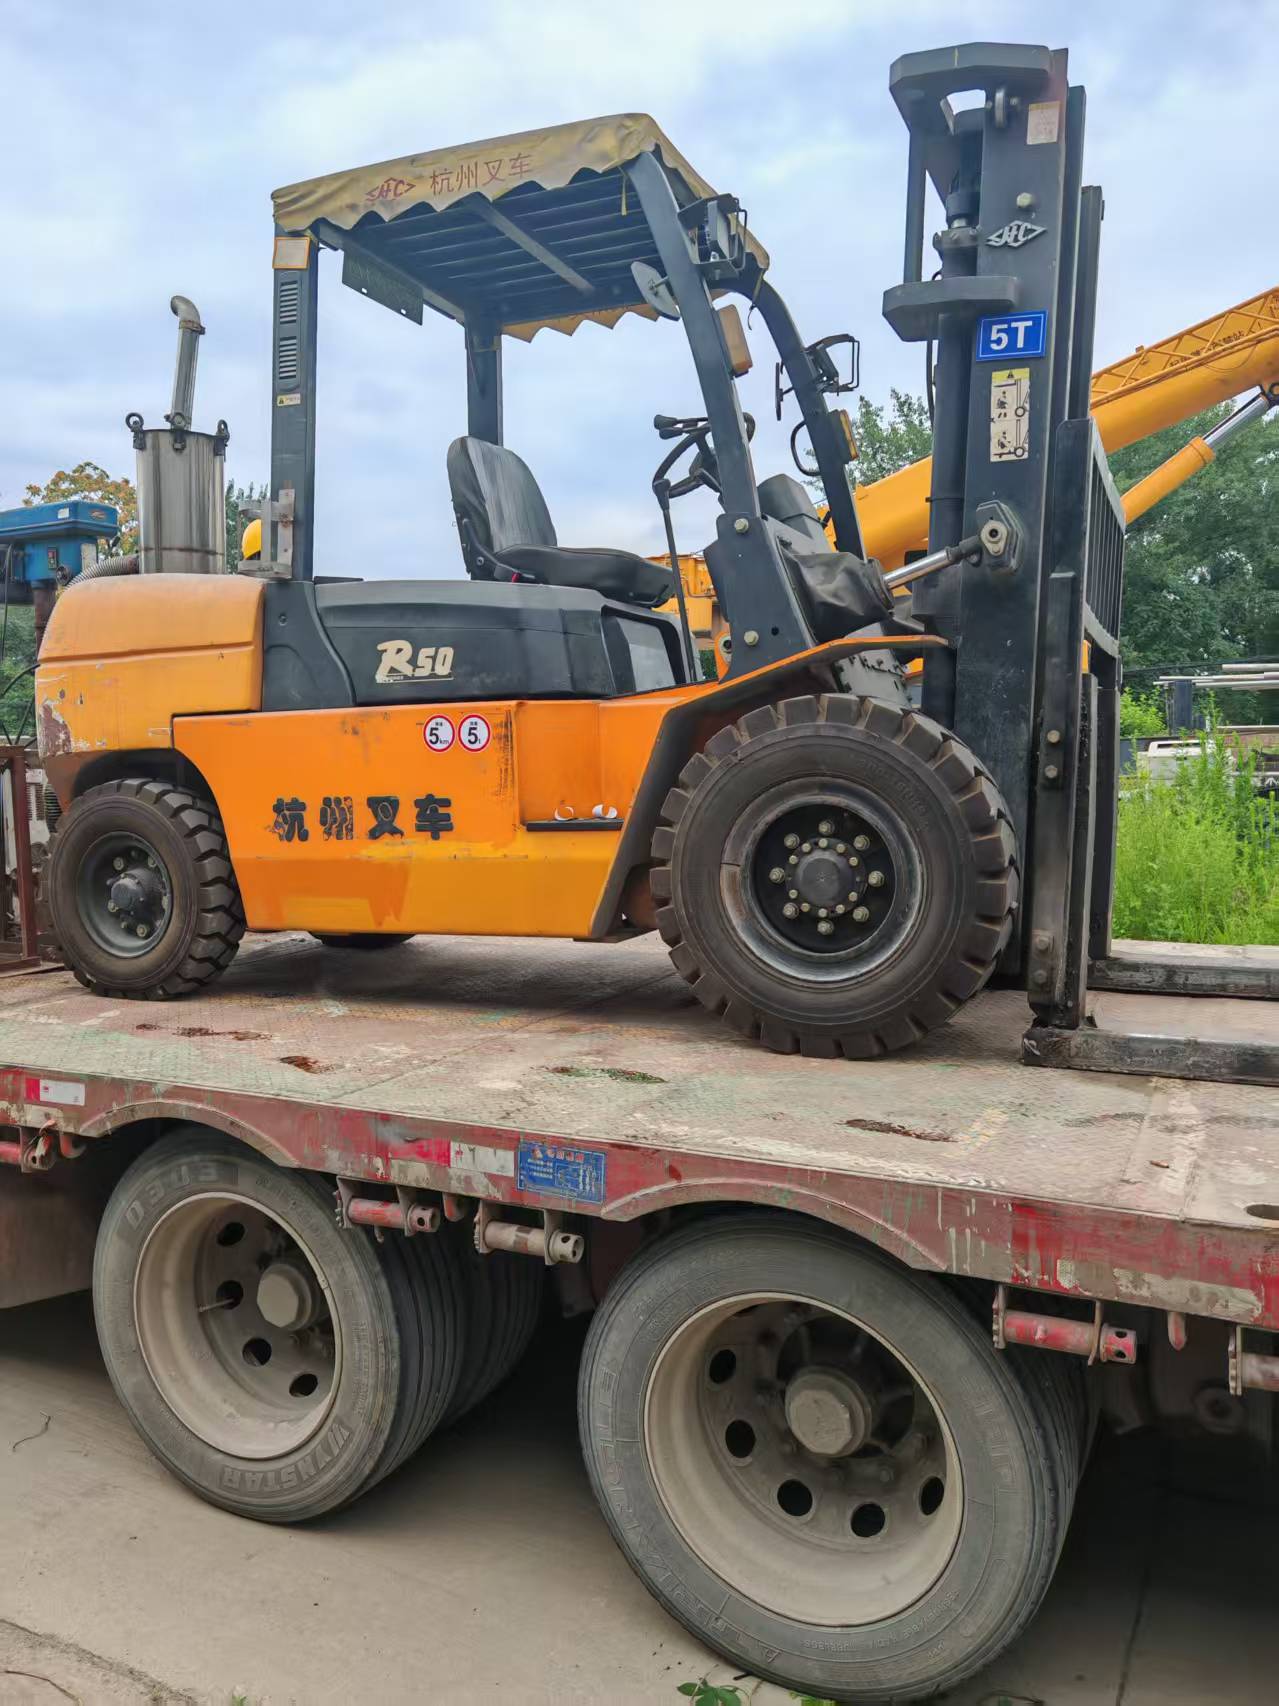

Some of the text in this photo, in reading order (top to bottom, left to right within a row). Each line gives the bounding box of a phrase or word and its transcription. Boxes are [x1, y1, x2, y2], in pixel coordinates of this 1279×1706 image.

[430, 153, 532, 196] 杭州叉车
[990, 320, 1034, 351] 5T
[375, 640, 454, 683] R50
[272, 794, 453, 842] 杭州叉车
